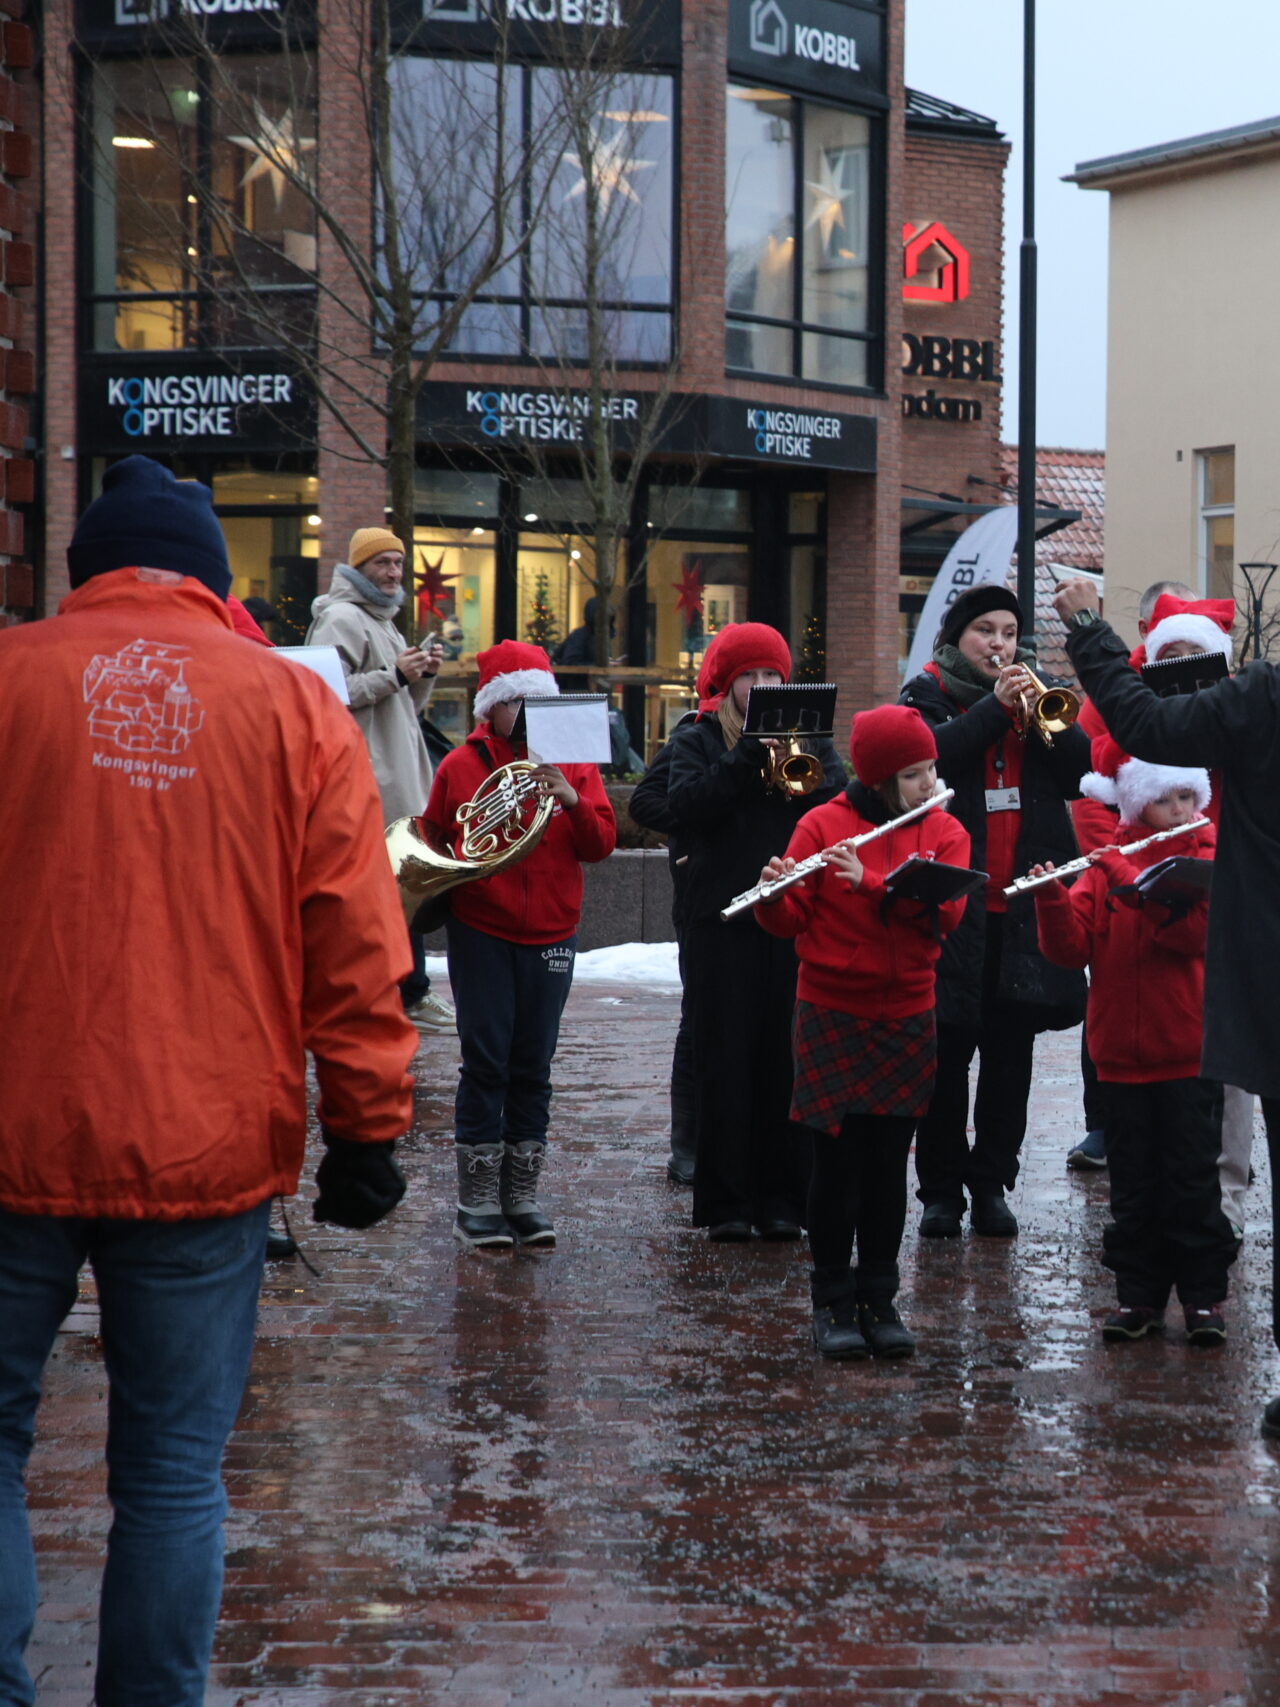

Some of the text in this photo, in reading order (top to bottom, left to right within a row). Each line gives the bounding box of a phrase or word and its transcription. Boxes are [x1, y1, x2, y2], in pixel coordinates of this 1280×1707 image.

[795, 24, 860, 71] KOBBL
[108, 374, 292, 406] KONGSVINGER
[123, 407, 233, 436] OPTISKE
[747, 408, 841, 438] KONGSVINGER
[755, 432, 812, 458] OPTISKE
[92, 752, 196, 780] Kongsvinger
